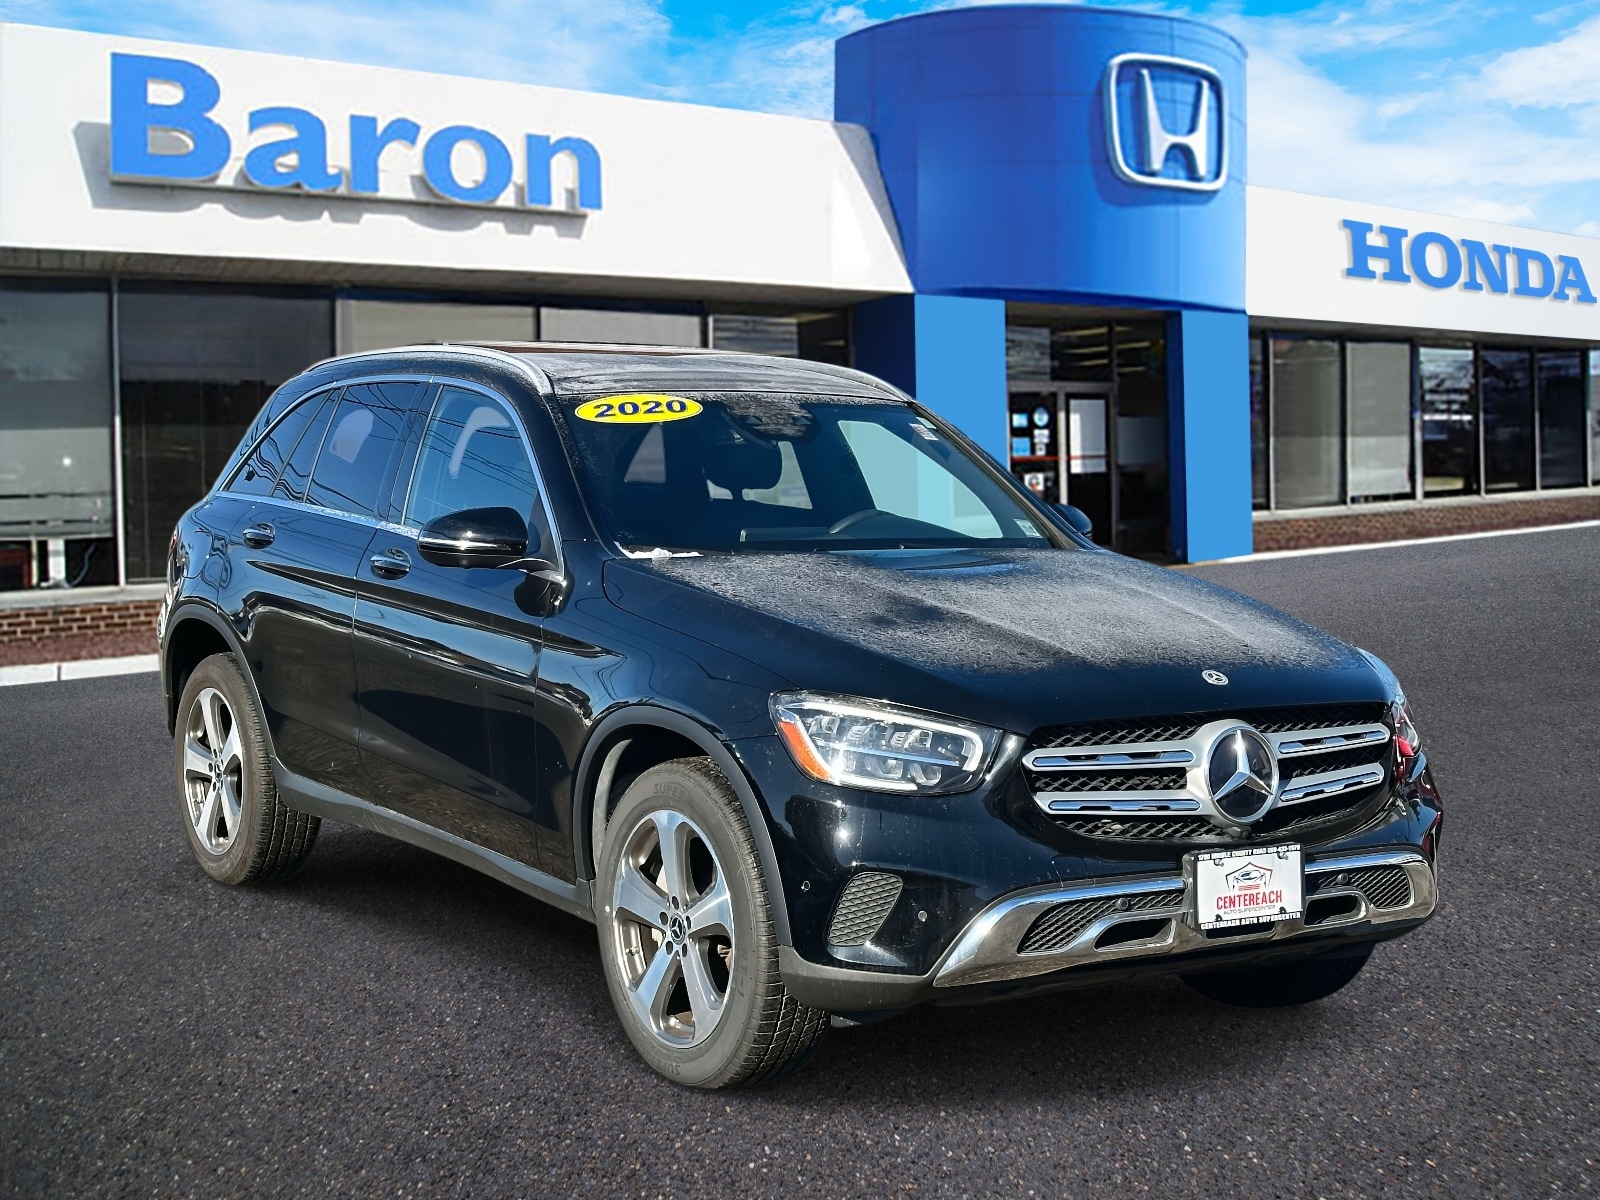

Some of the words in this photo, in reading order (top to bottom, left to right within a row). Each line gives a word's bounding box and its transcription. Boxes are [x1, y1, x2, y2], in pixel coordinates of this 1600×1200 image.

[110, 52, 603, 211] Baron
[1342, 218, 1598, 304] HONDA
[593, 399, 688, 418] 2020
[1216, 890, 1282, 910] CENTEREACH
[1238, 904, 1276, 914] SUPERCENTER
[1200, 919, 1240, 930] CENTEREACH
[1240, 917, 1258, 926] AUTO
[1258, 911, 1301, 923] SUPERCENTER
